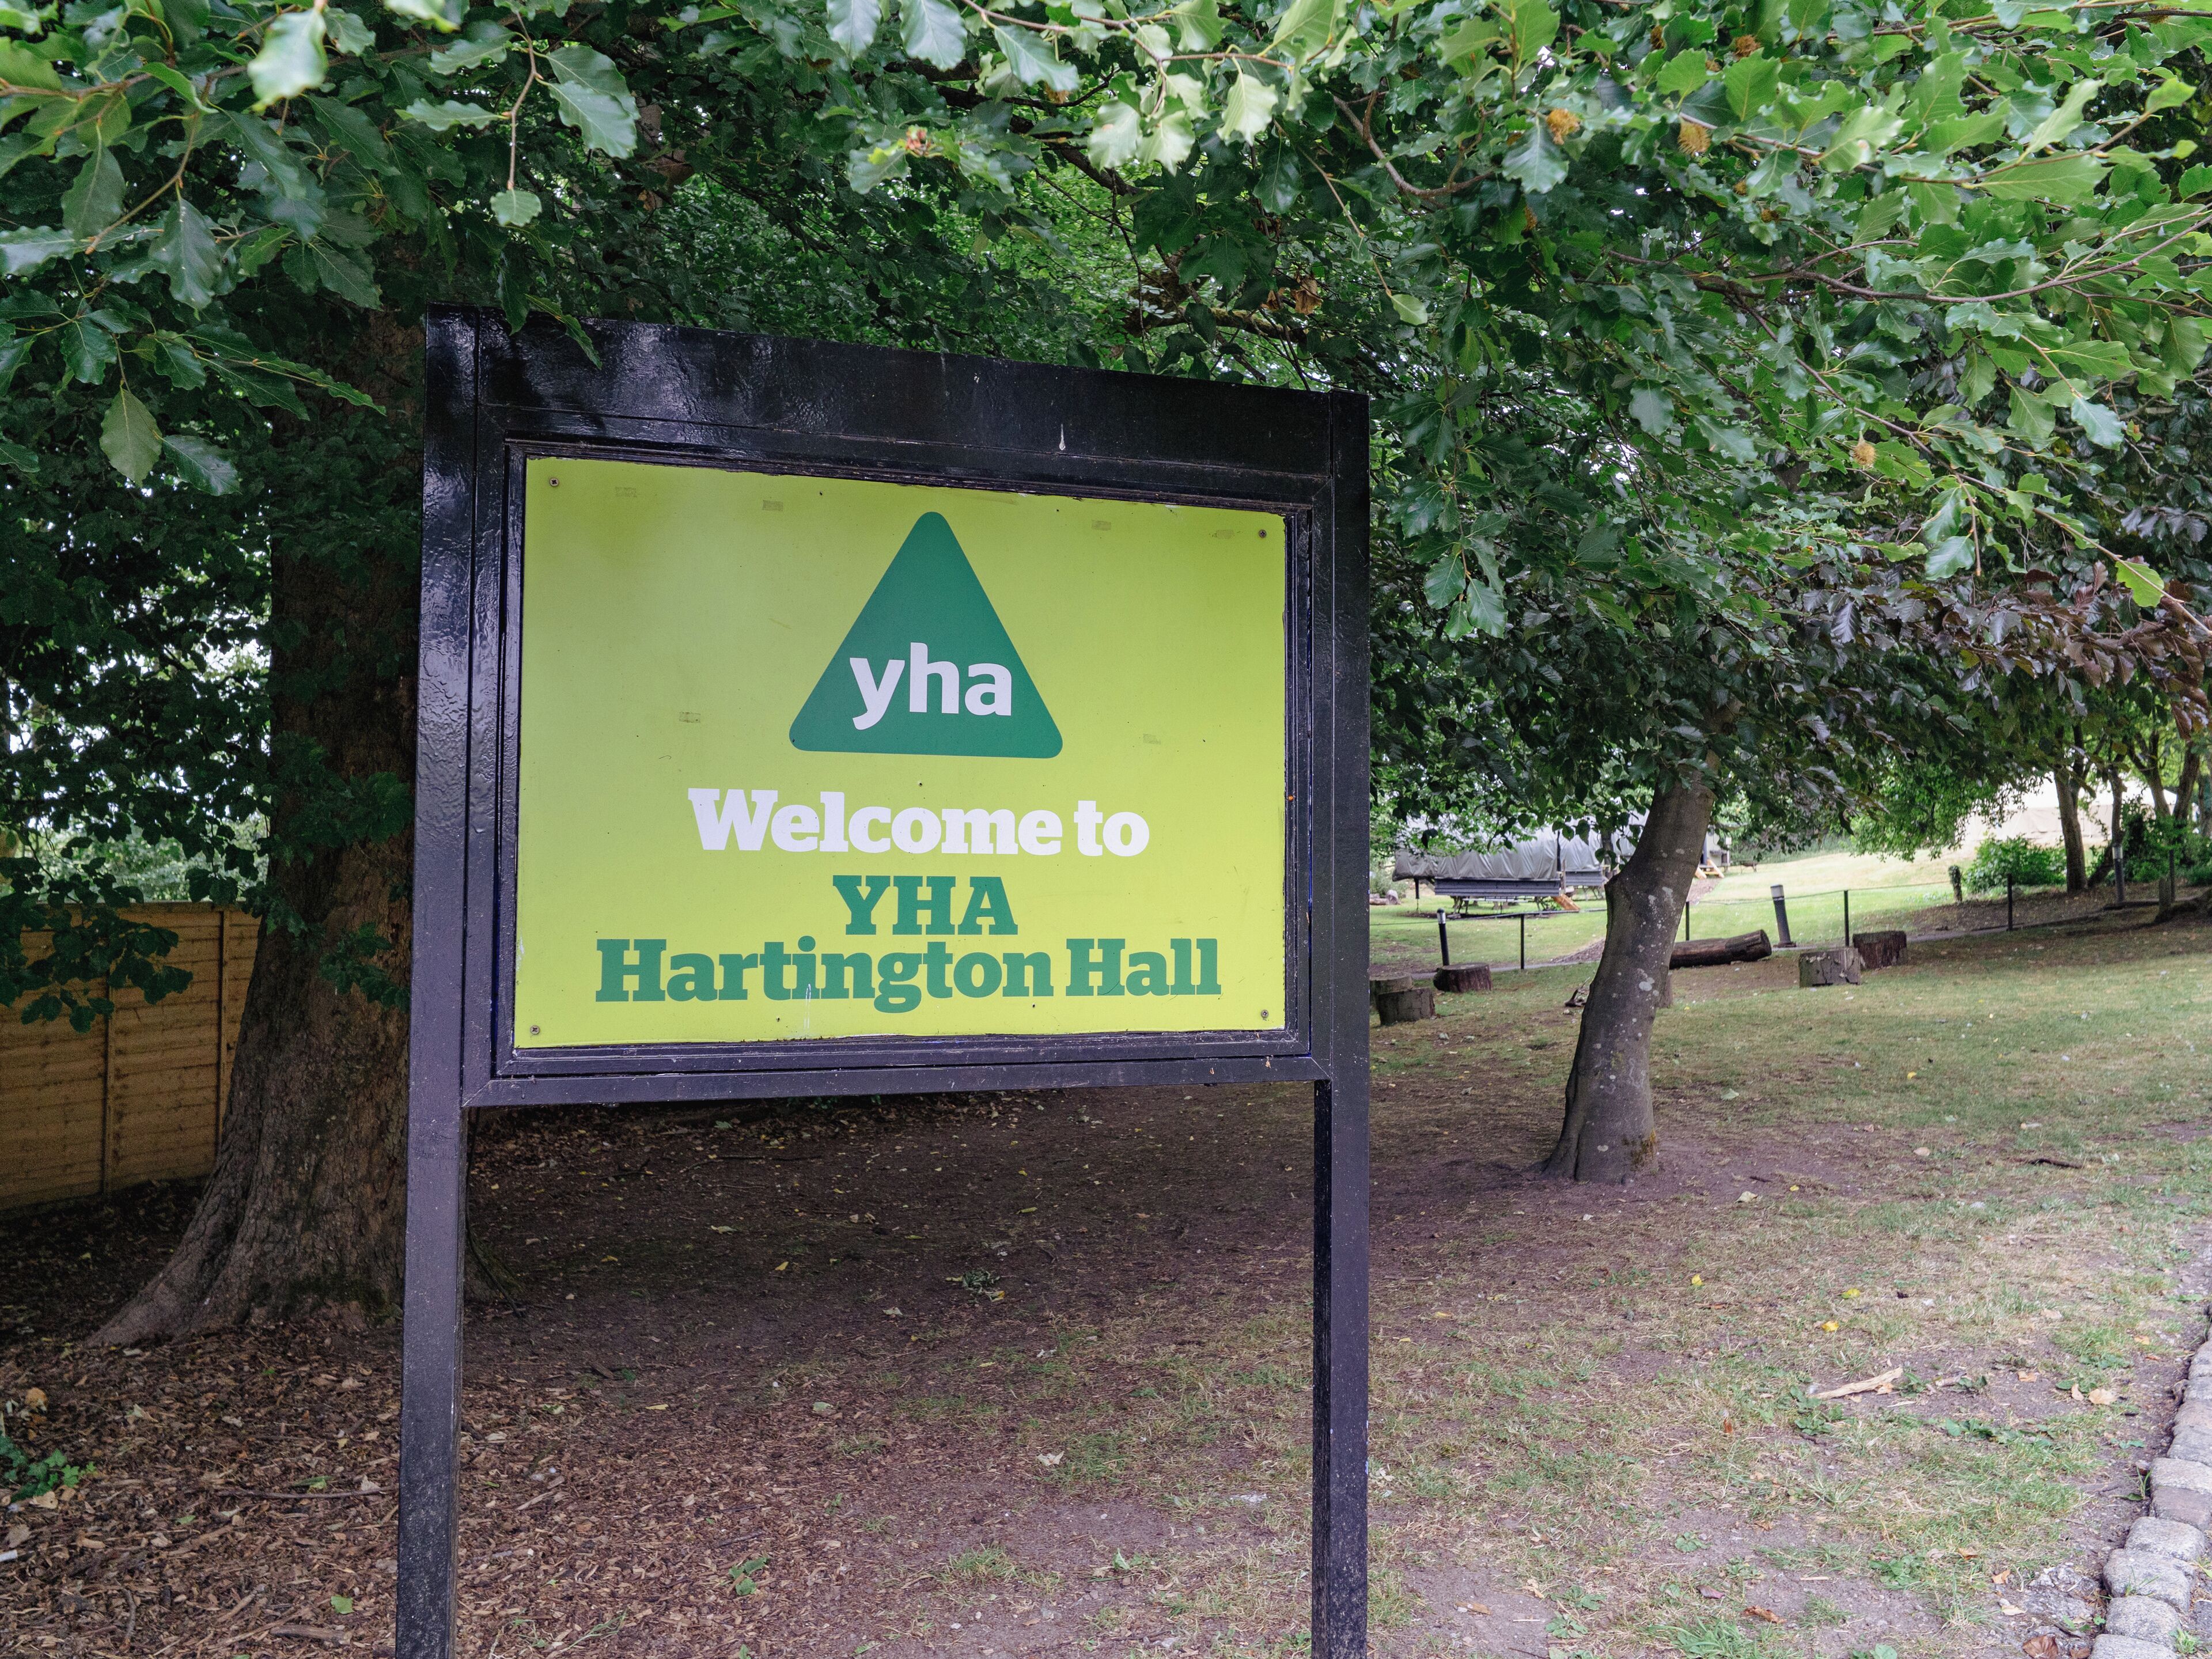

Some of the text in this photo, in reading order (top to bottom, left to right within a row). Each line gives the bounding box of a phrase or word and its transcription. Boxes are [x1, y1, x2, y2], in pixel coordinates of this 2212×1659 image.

[850, 642, 1012, 730] yha
[687, 787, 1150, 857] Welcome to
[832, 874, 1018, 935] YHA
[595, 935, 1222, 1013] Hartington Hall
